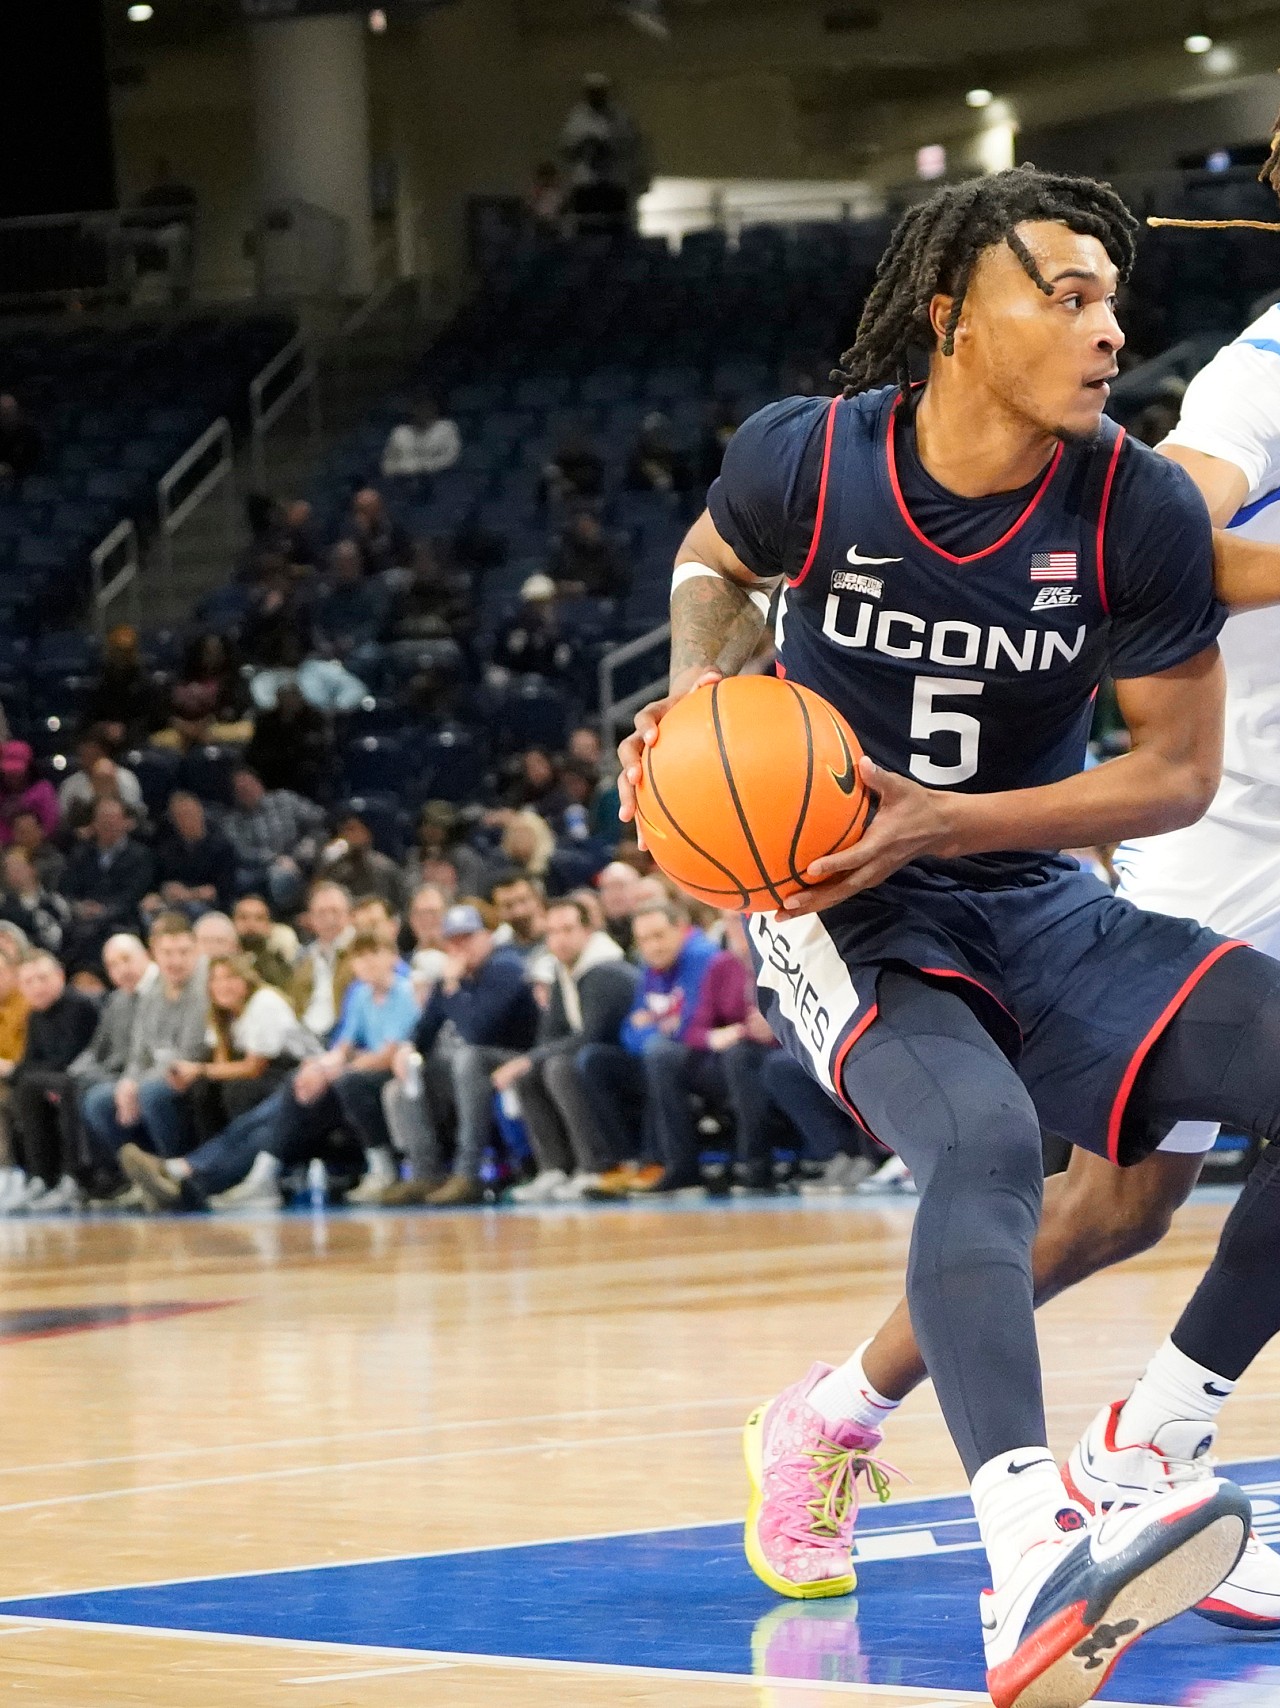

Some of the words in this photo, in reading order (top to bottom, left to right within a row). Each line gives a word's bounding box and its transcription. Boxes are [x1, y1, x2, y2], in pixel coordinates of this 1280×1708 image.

[1033, 594, 1082, 606] EAST
[1038, 586, 1073, 596] BIG
[822, 593, 1087, 672] UCONN
[909, 675, 985, 786] 5
